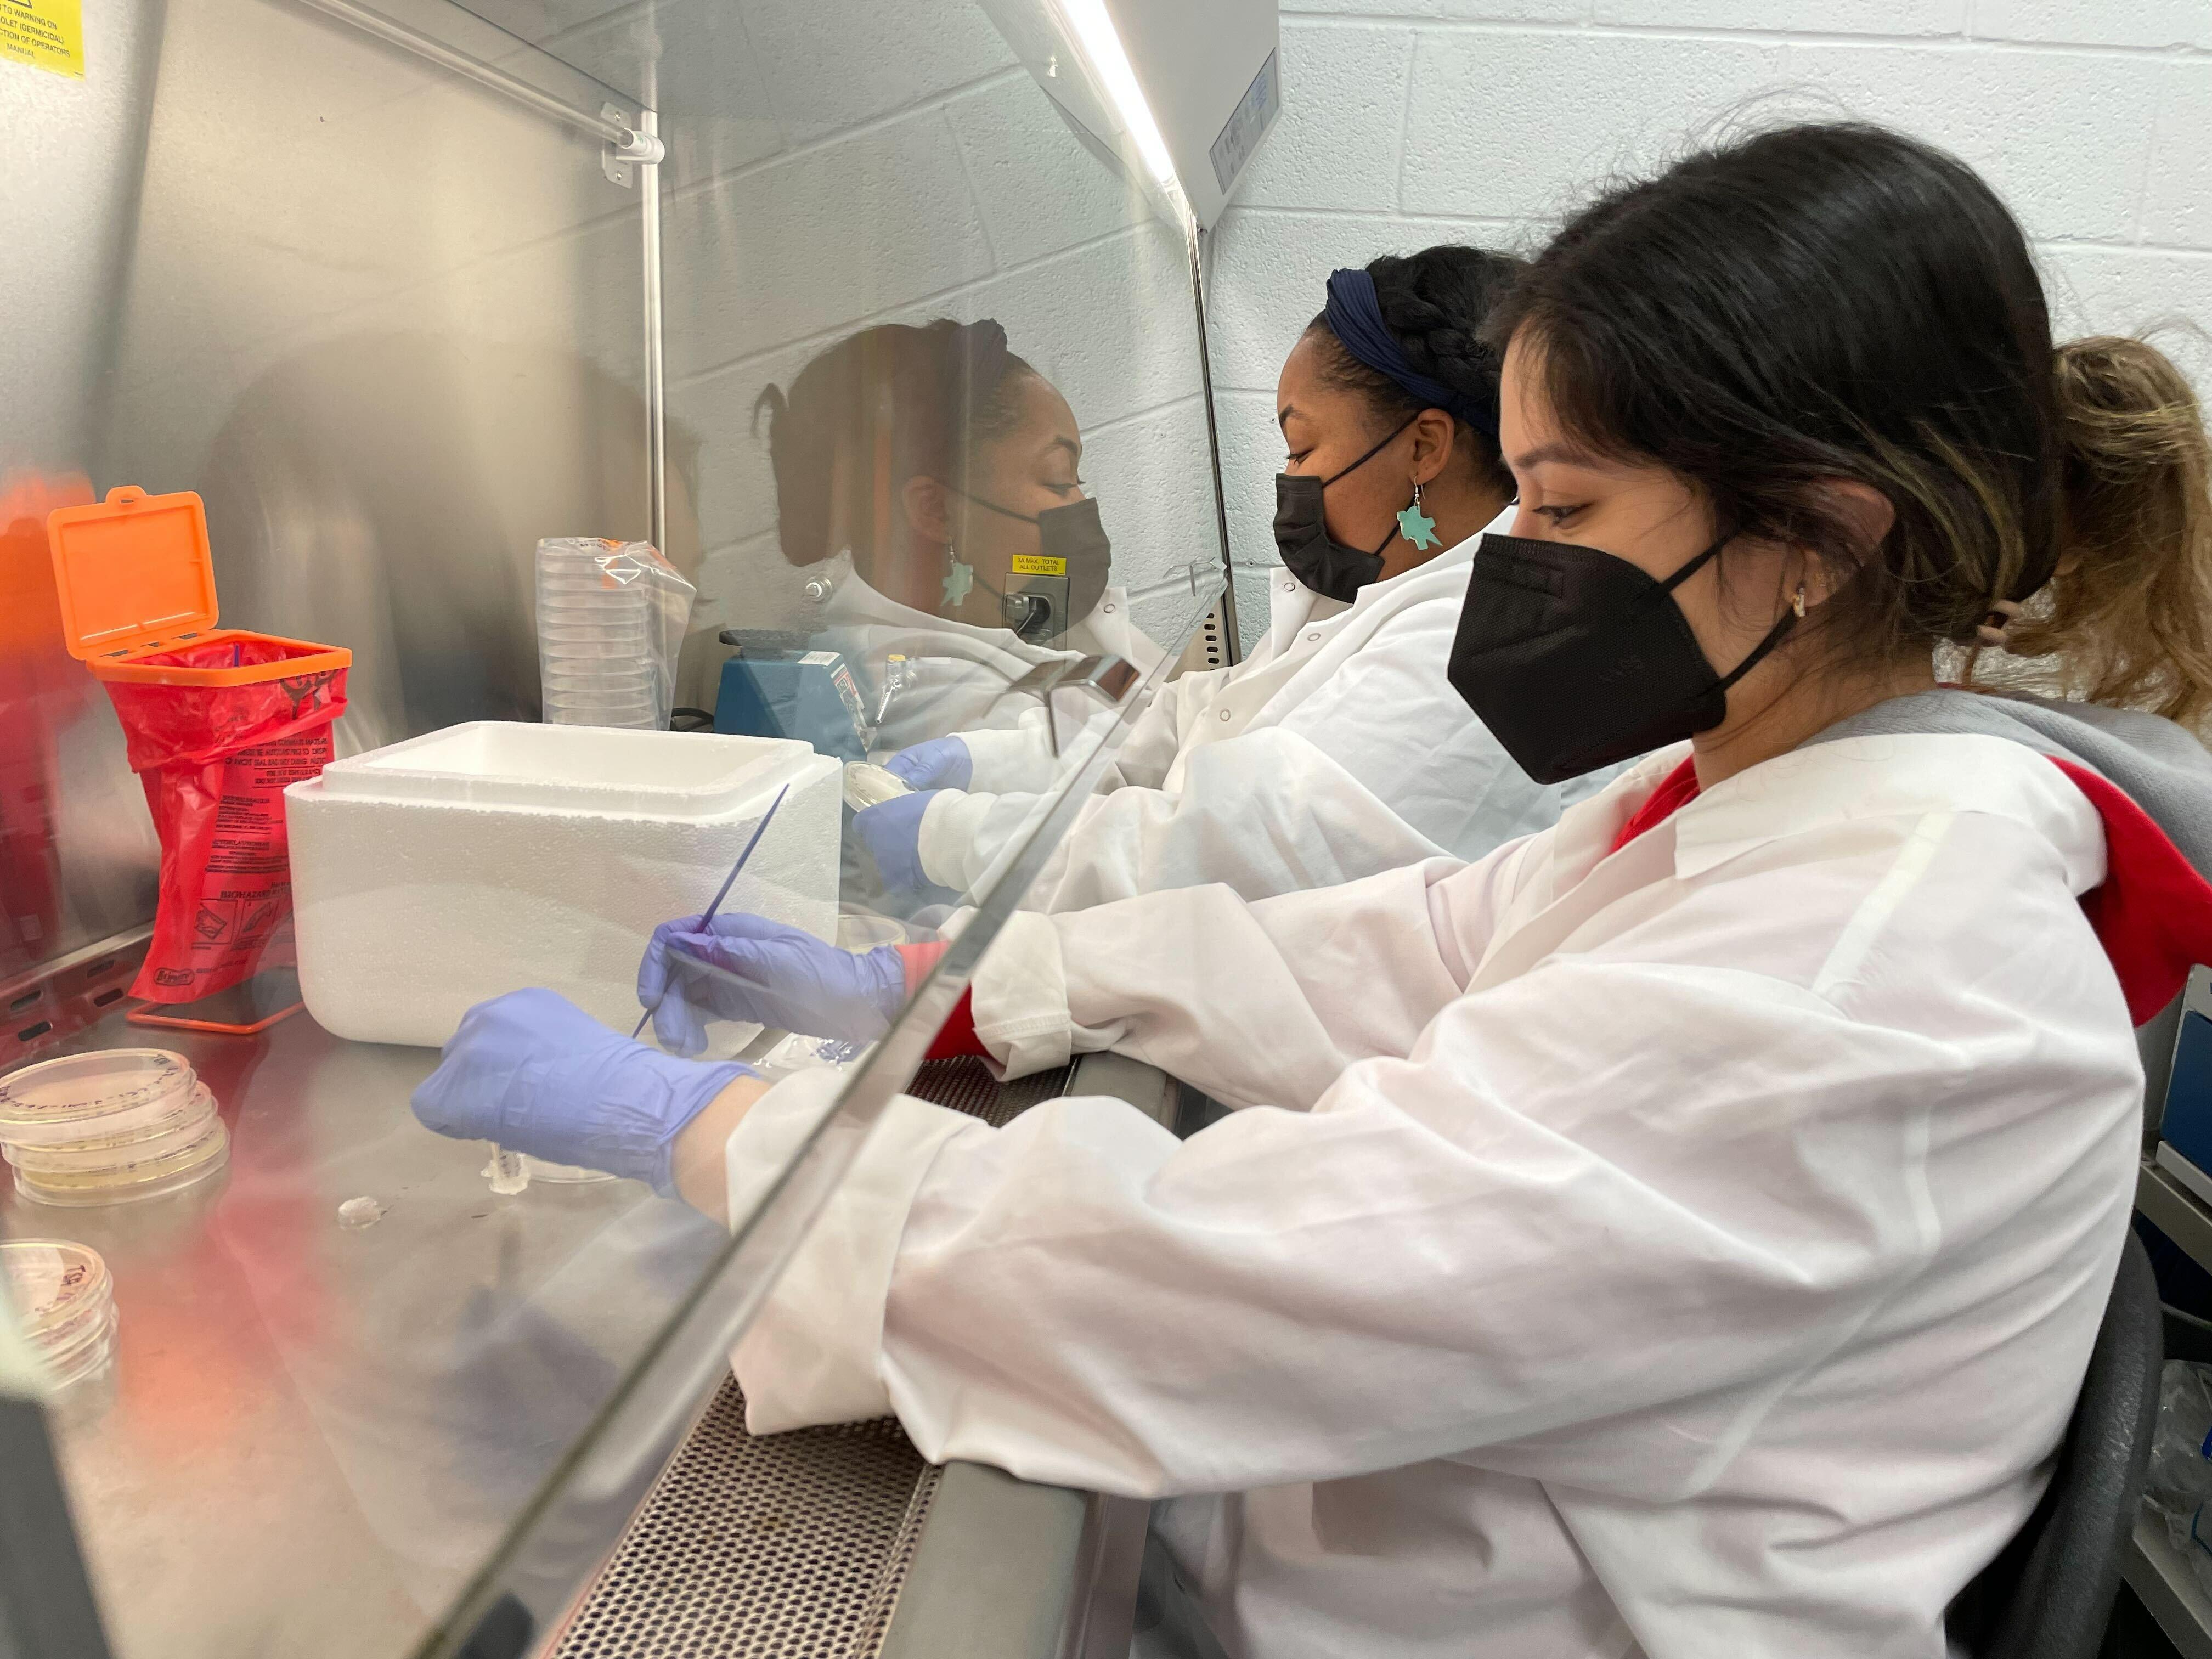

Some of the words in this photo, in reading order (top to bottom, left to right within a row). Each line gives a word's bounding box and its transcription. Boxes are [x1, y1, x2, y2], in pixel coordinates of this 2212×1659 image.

[3, 5, 12, 14] TO
[14, 9, 46, 26] WARNING
[47, 20, 57, 30] ON
[20, 22, 64, 45] (GERMICIDAL)
[21, 35, 30, 44] OF
[32, 39, 70, 58] OPERATORS
